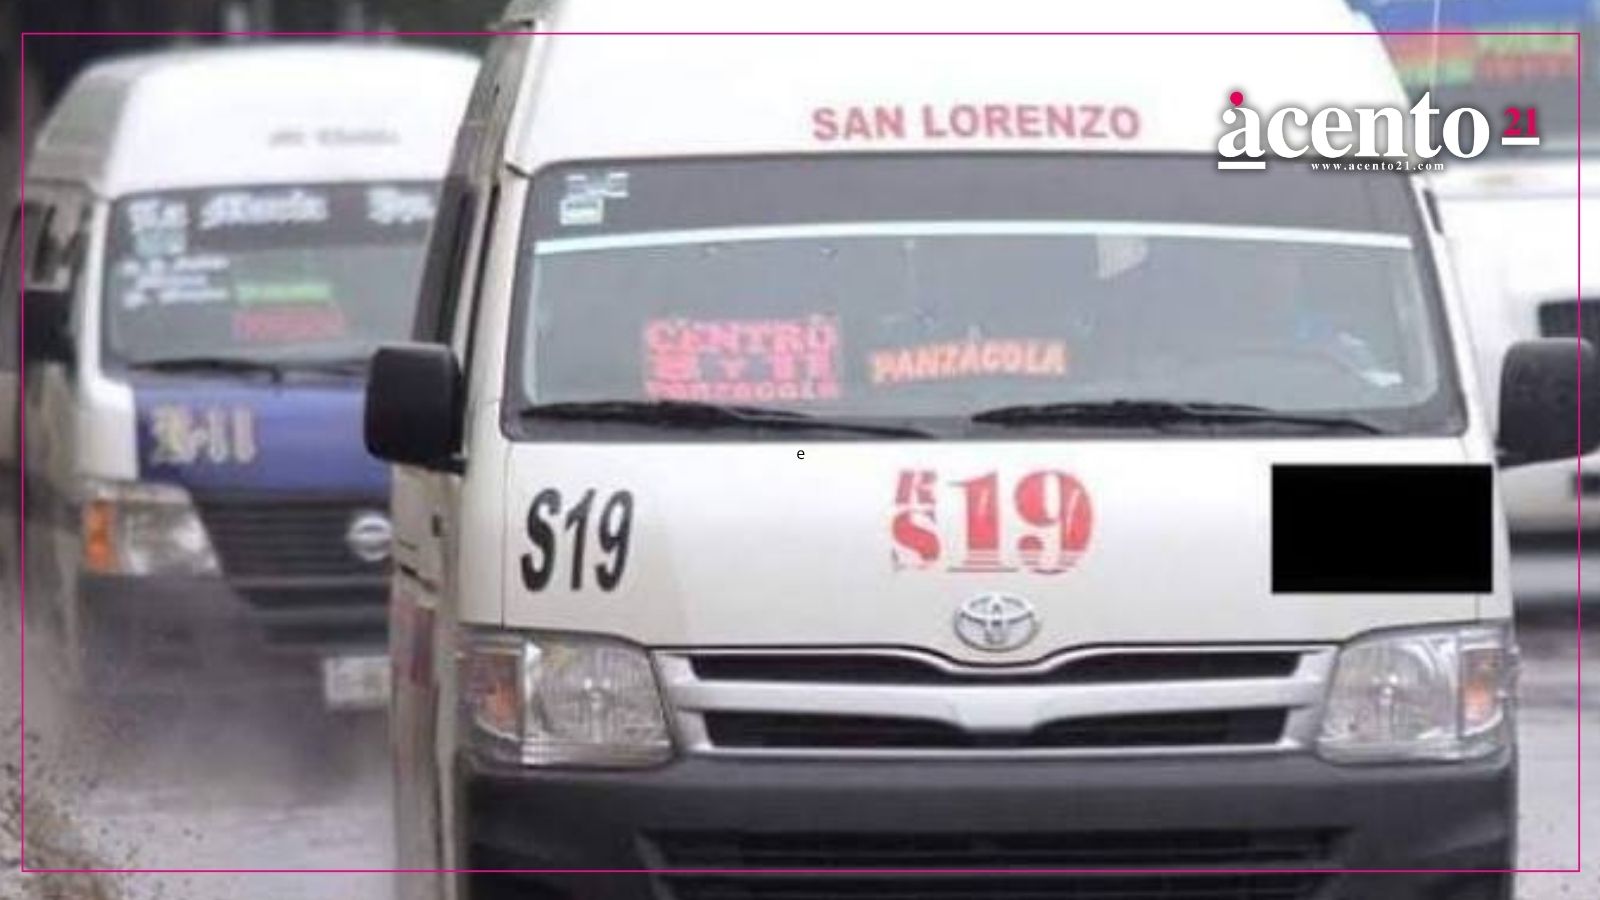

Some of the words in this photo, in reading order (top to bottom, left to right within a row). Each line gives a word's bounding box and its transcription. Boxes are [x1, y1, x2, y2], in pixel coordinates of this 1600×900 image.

[812, 105, 906, 142] SAN
[923, 103, 1140, 140] LORENZO
[520, 488, 635, 593] S19
